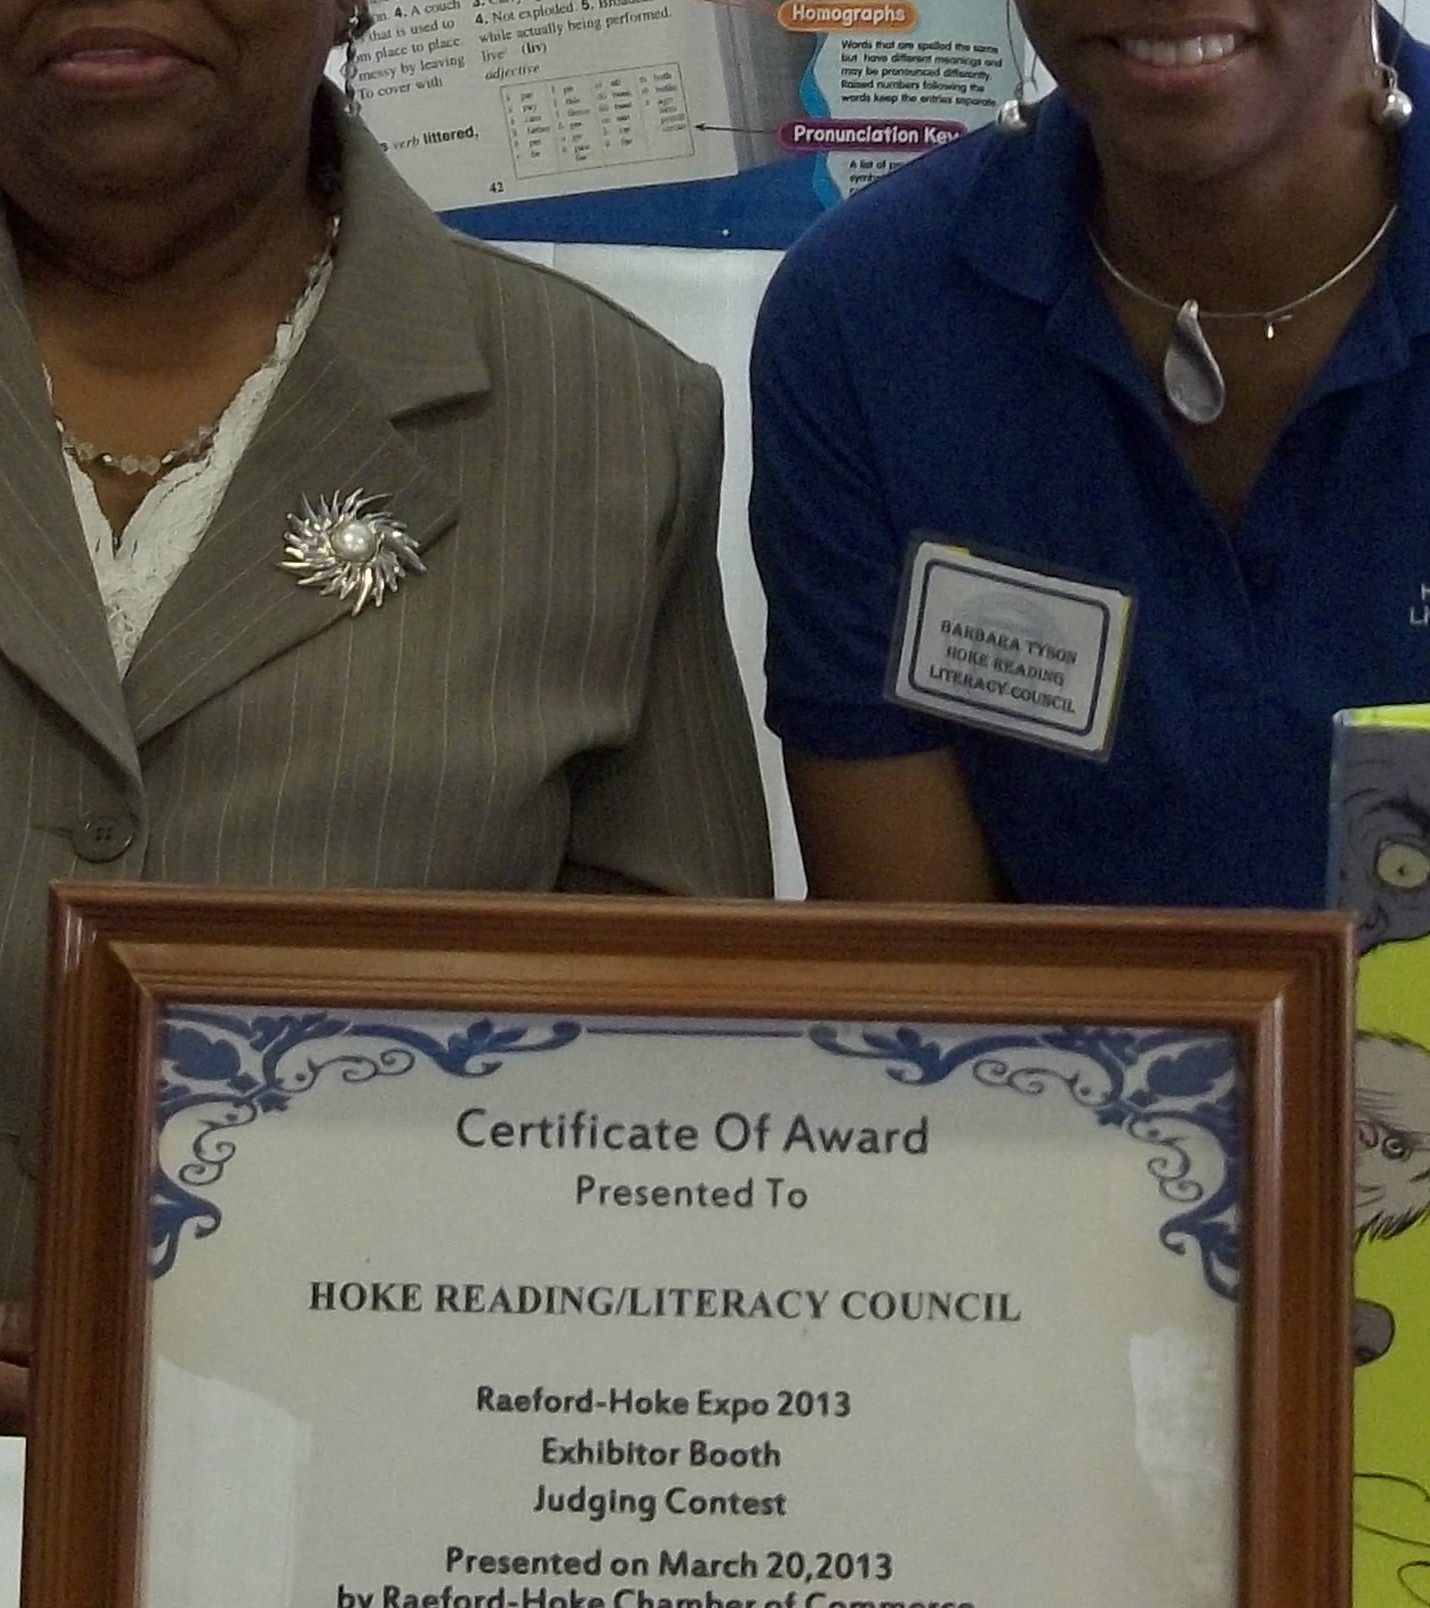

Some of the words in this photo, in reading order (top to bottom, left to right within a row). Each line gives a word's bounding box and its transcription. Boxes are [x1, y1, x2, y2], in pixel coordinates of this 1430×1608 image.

[793, 3, 905, 26] Homographs
[795, 125, 918, 143] Pronunciation
[924, 125, 960, 145] Key
[490, 182, 503, 193] 42
[941, 620, 1020, 650] BARBARA
[1026, 640, 1077, 664] TYSON
[947, 645, 988, 666] HOKE
[994, 658, 1064, 686] READING
[929, 664, 1008, 695] LITERACY
[1011, 686, 1075, 713] COUNCIL
[457, 1108, 698, 1151] Certificate
[715, 1113, 770, 1151] Of
[784, 1114, 928, 1154] Award
[577, 1175, 753, 1208] Presented
[766, 1178, 807, 1209] To
[310, 1282, 421, 1311] HOKE
[436, 1285, 828, 1319] READING/LITERACY
[841, 1291, 1020, 1321] COUNCIL
[477, 1386, 688, 1415] Raeford-Hoke
[698, 1390, 768, 1423] Expo
[778, 1391, 850, 1417] 2013
[542, 1437, 680, 1466] Exhibitor
[690, 1440, 780, 1467] Booth
[534, 1485, 656, 1522] Judging
[665, 1487, 786, 1515] Contest
[447, 1546, 601, 1576] Presented
[610, 1558, 648, 1576] on
[659, 1550, 757, 1578] March
[767, 1552, 891, 1583] 20,2013
